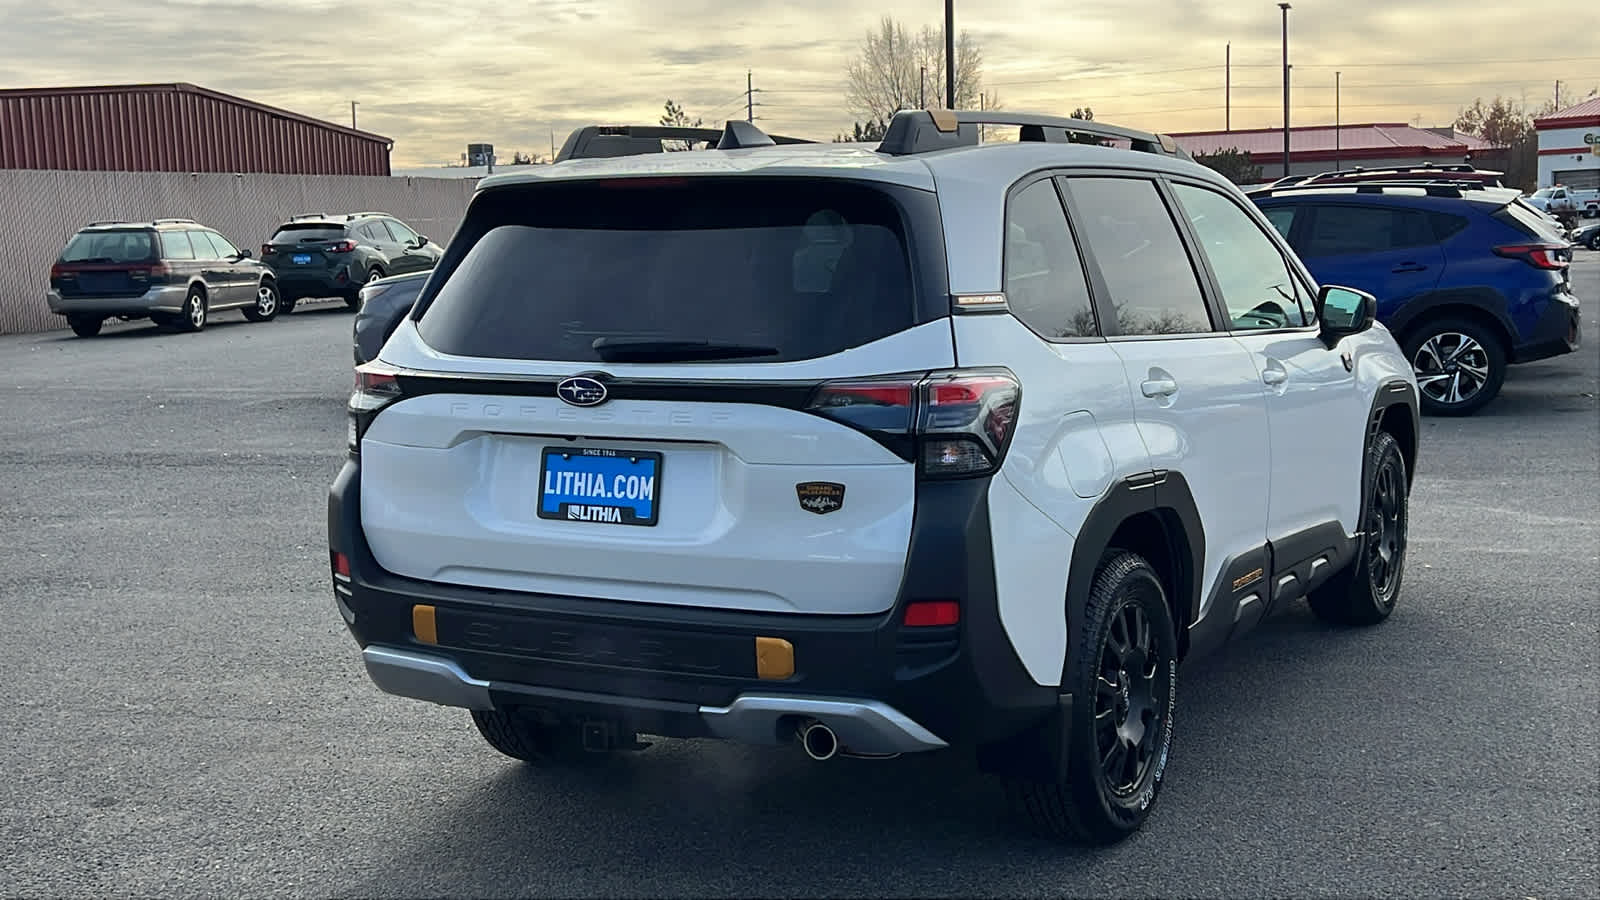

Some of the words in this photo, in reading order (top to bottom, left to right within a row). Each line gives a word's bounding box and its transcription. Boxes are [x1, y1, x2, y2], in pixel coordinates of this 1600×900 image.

[450, 402, 735, 425] FORESTER
[583, 448, 600, 456] SINCE
[544, 470, 654, 501] LITHIA.COM
[579, 505, 622, 523] LITHIA
